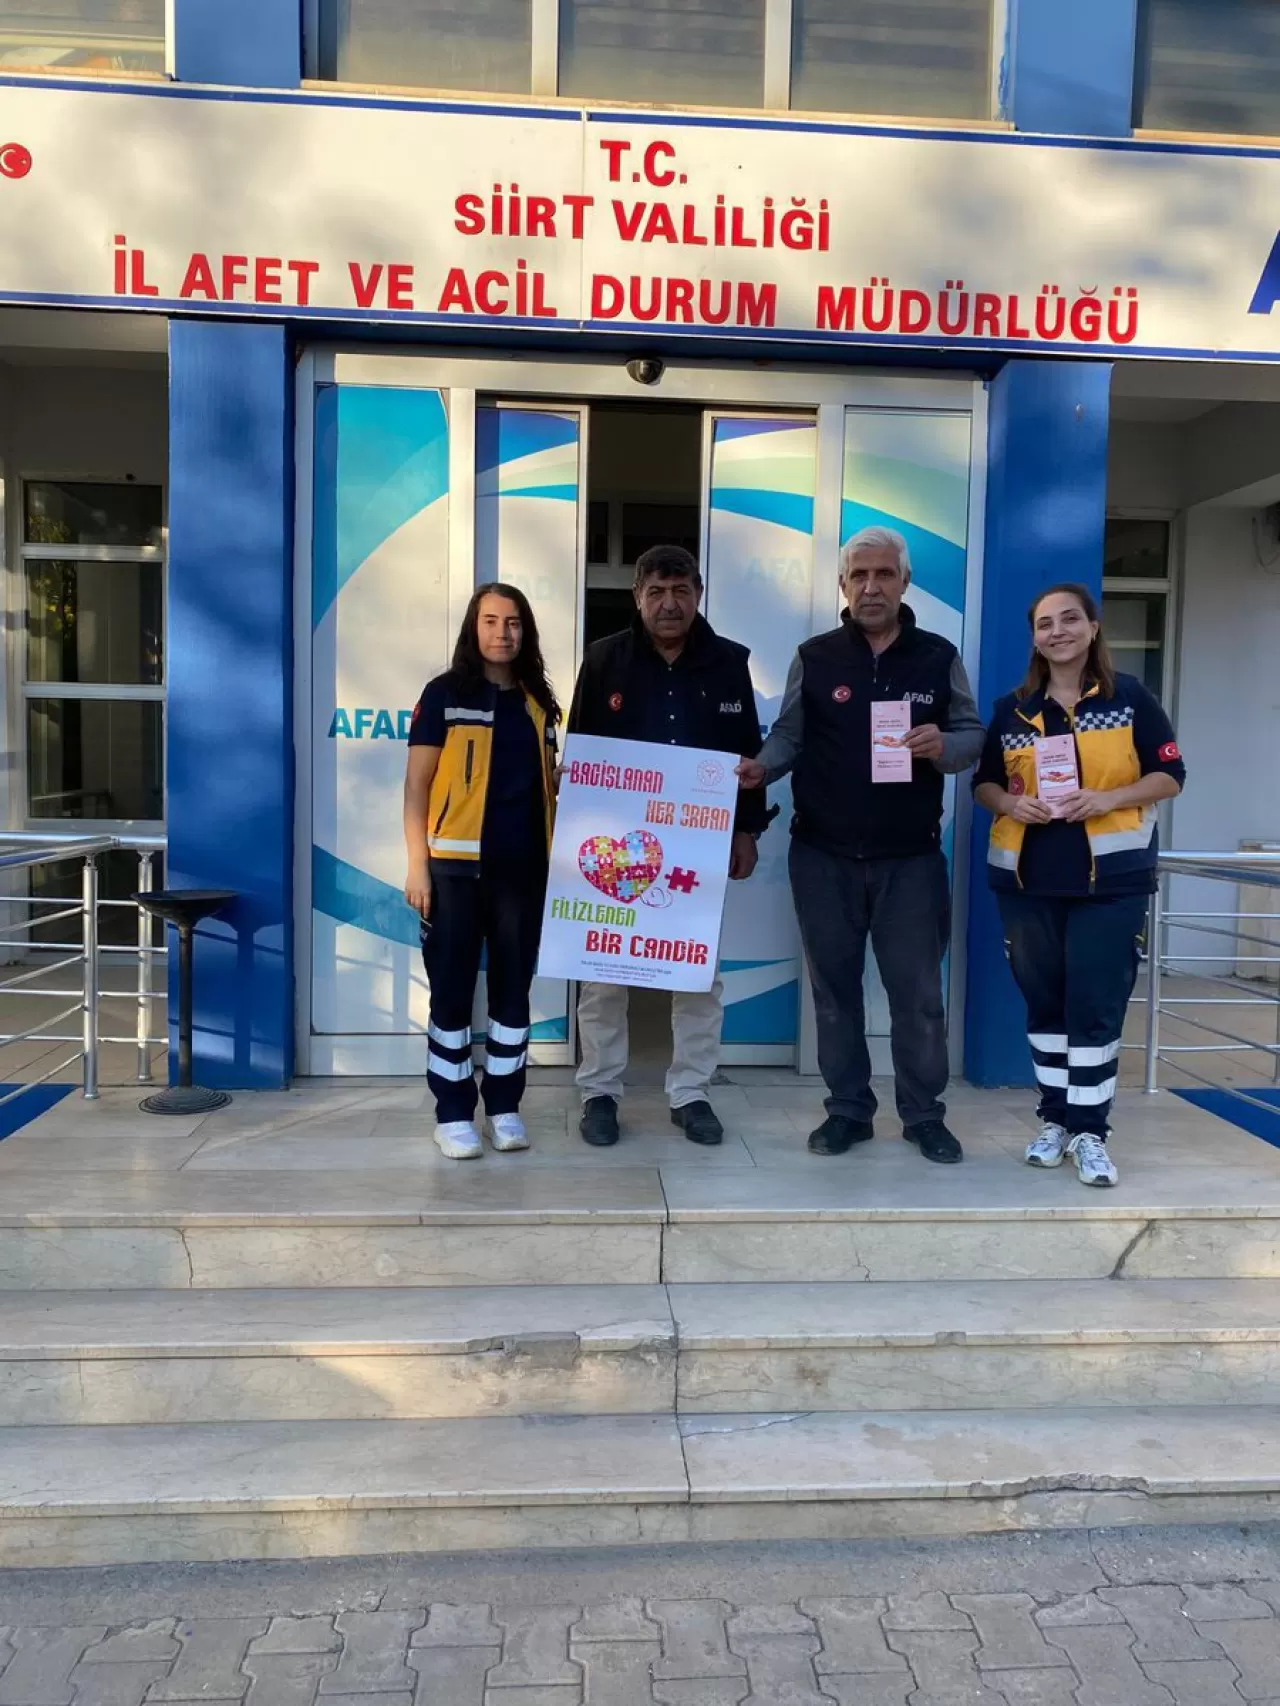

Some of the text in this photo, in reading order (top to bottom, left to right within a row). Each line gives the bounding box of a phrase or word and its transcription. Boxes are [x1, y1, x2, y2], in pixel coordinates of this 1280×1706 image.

[600, 138, 688, 188] T.C.
[454, 182, 830, 252] SİİRT VALİLİĞİ
[113, 234, 1139, 345] İL AFET VE ACİL DURUM MÜDÜRLÜĞÜ
[902, 691, 934, 705] AFAD
[645, 800, 675, 826] HER
[587, 928, 622, 955] BİR
